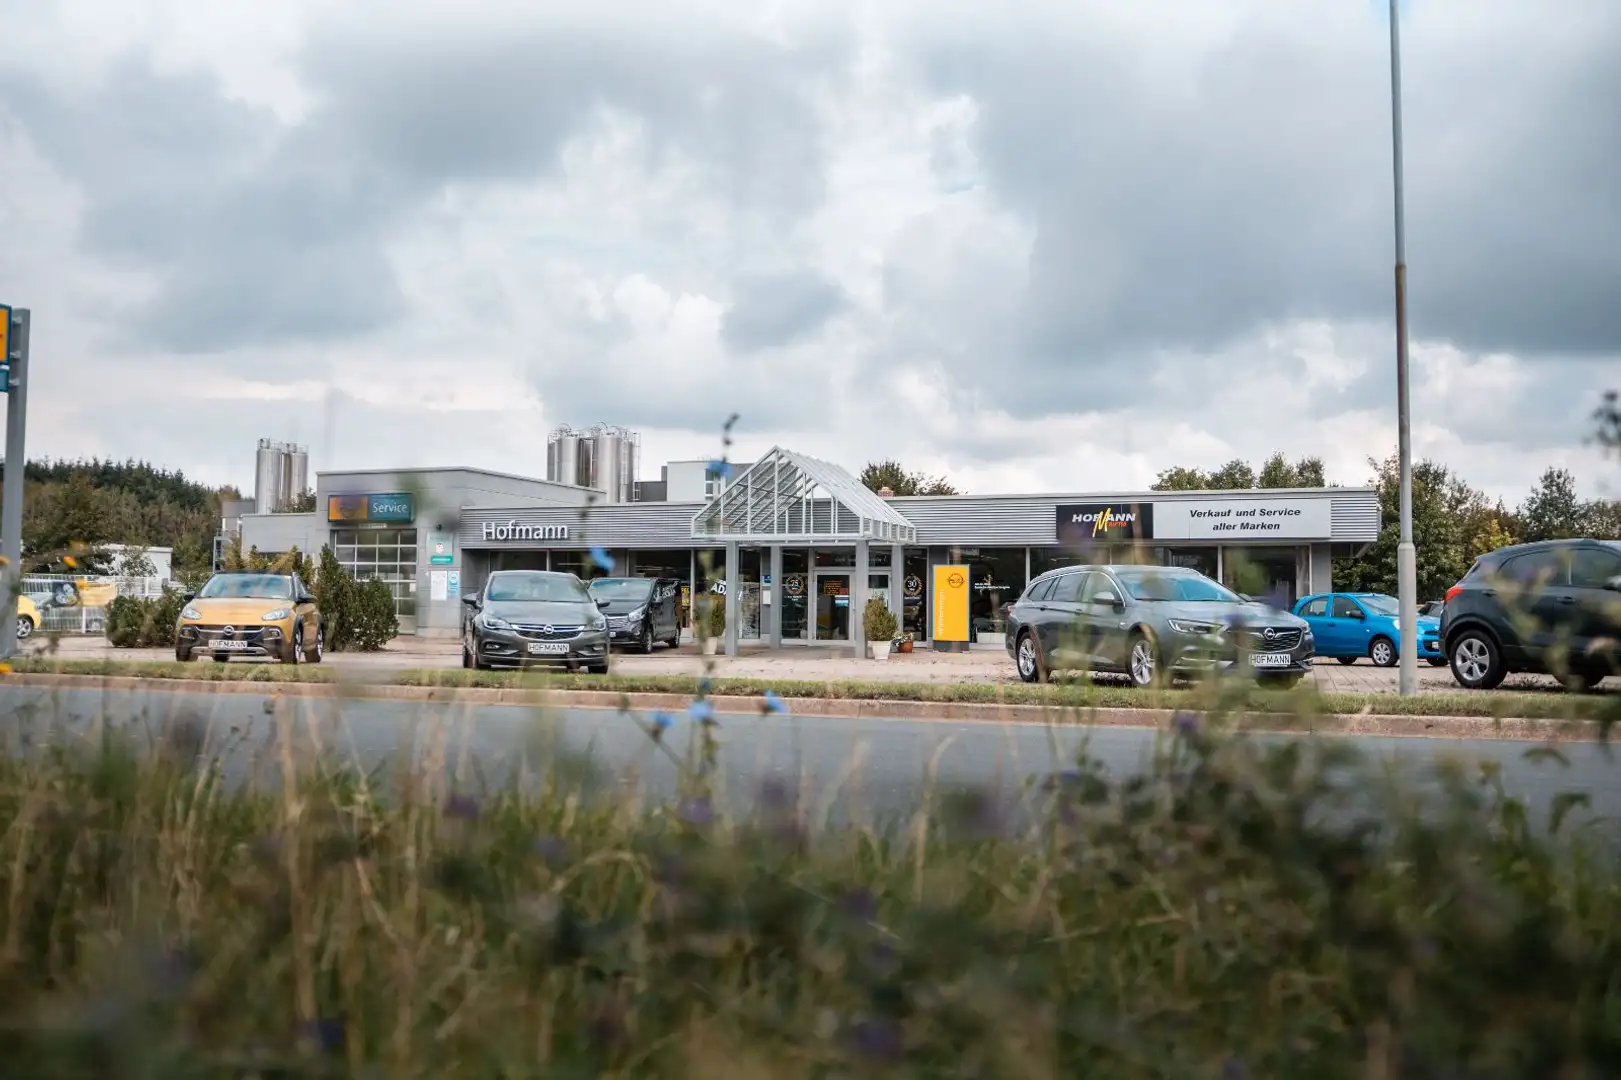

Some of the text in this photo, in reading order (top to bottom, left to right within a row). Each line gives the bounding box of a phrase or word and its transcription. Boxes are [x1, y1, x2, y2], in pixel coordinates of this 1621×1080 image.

[373, 502, 408, 514] Service
[1190, 507, 1301, 518] Verkauf und Service
[482, 520, 568, 540] Hofmann
[1212, 522, 1280, 531] aller Marken
[529, 644, 569, 652] HOFMANN
[1250, 655, 1290, 664] HOFMANN
